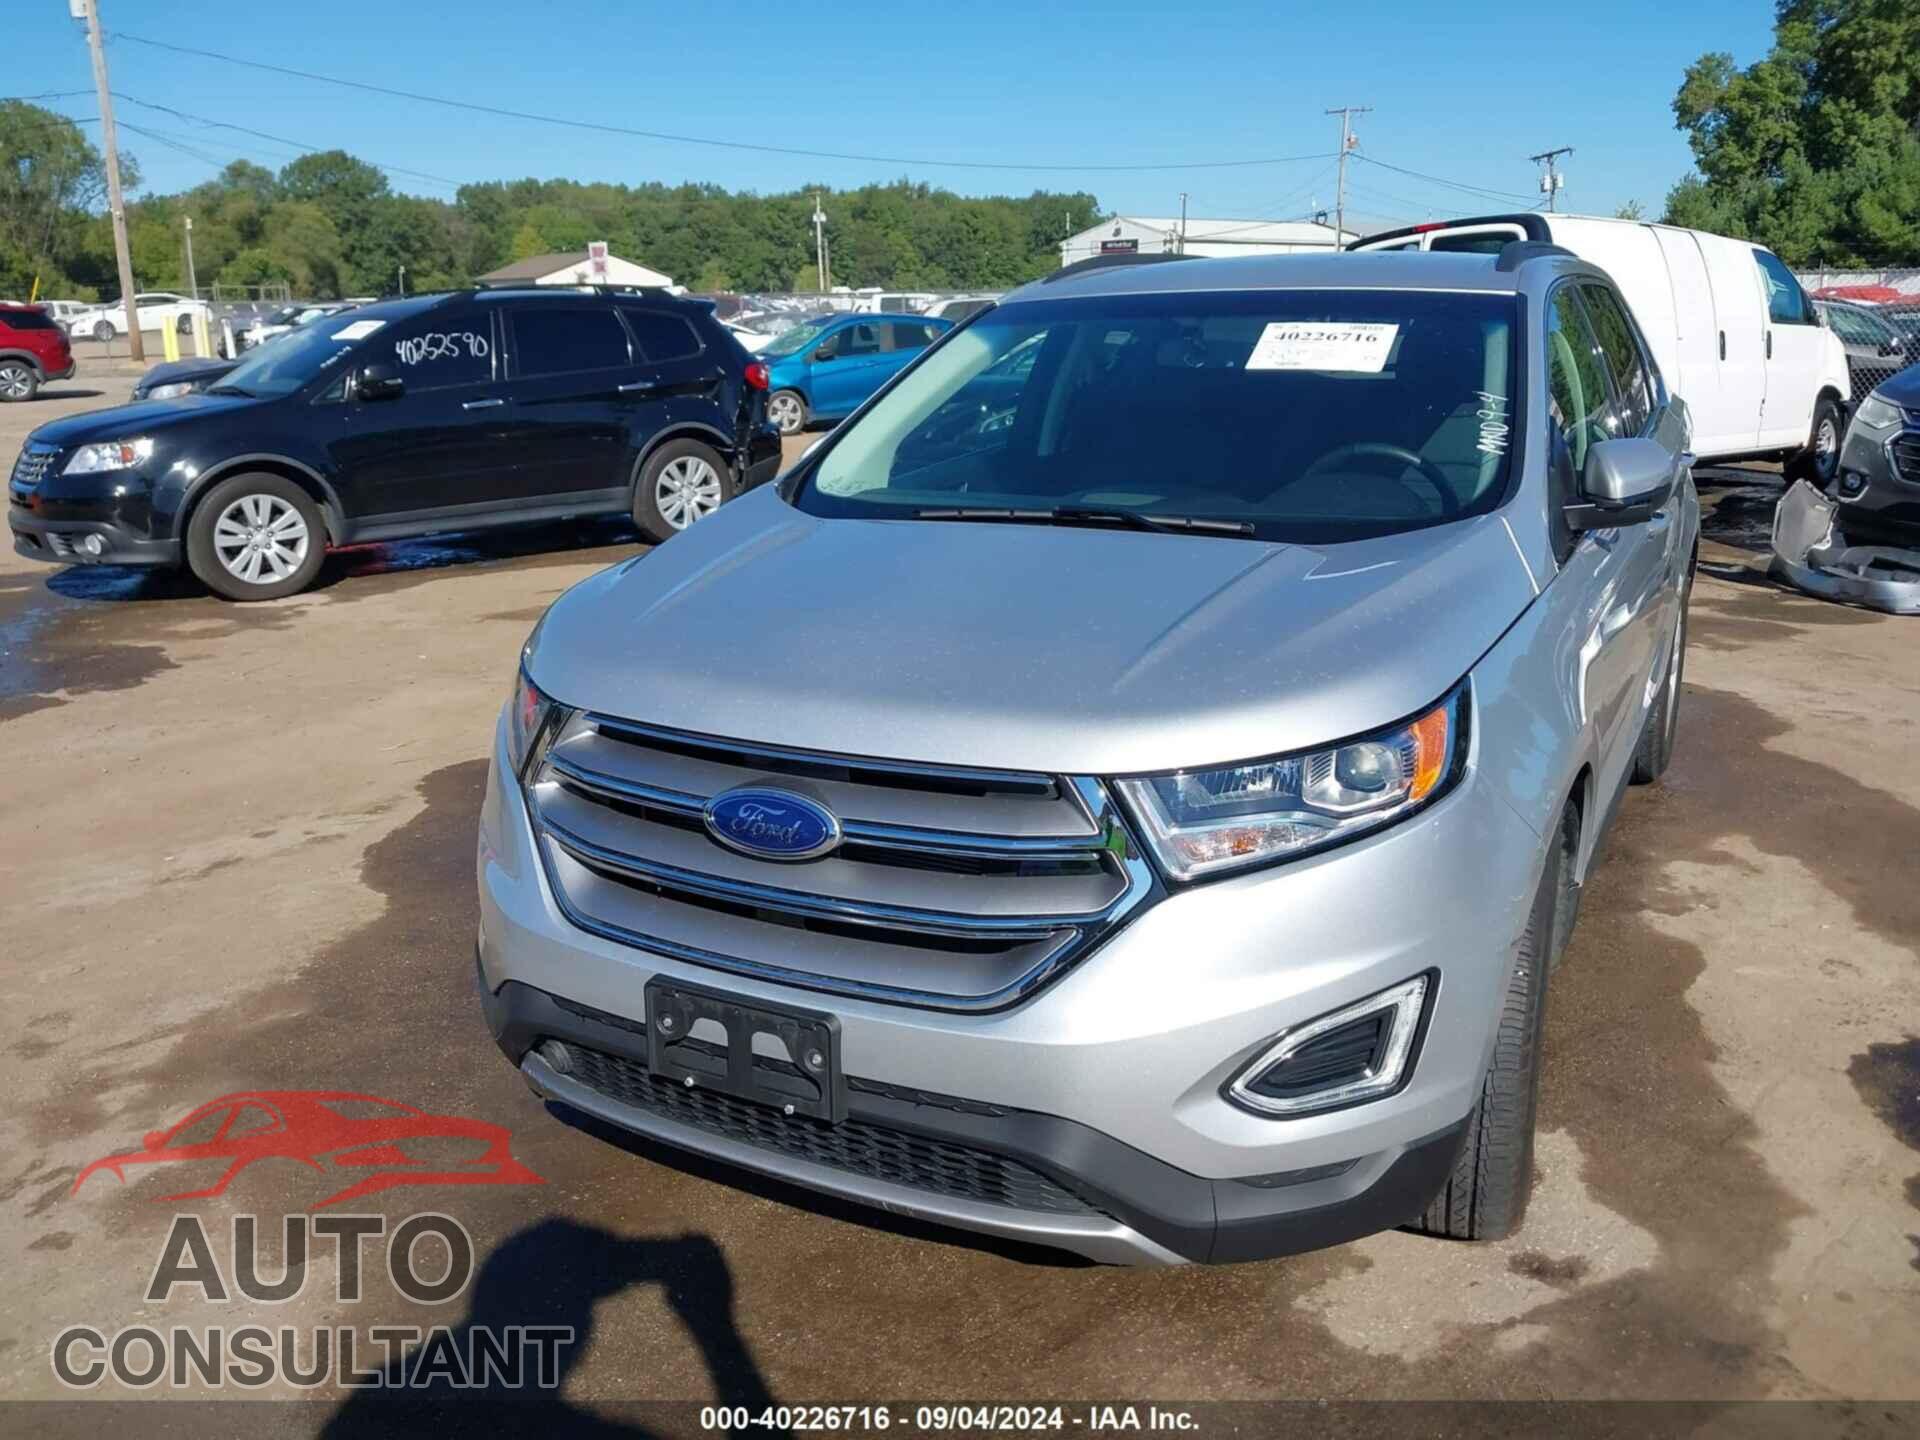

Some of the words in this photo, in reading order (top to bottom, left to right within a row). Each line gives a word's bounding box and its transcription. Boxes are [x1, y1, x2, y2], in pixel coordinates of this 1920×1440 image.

[395, 332, 489, 366] 40252590
[1274, 331, 1378, 343] 40226716
[730, 802, 803, 846] Ford
